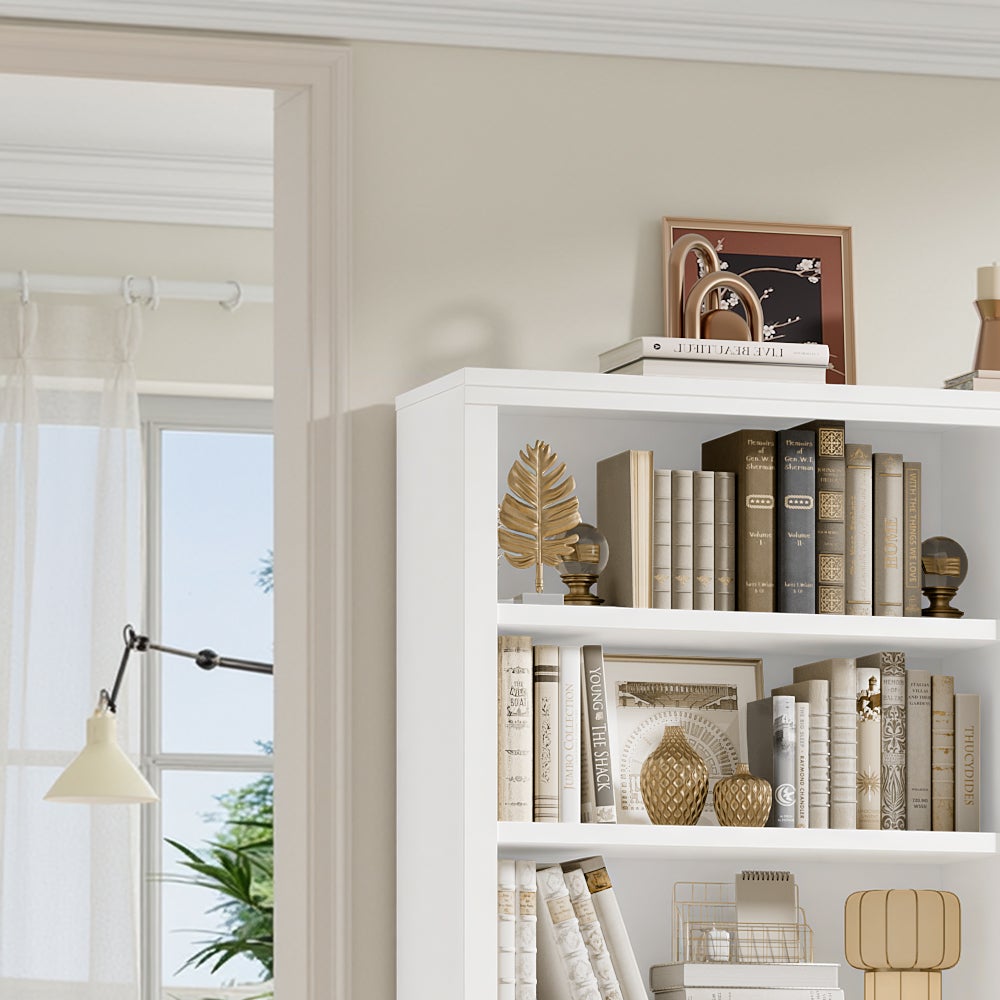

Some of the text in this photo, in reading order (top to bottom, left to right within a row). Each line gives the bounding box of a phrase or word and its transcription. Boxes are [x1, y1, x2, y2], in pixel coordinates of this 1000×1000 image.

[784, 463, 814, 471] Sherman
[884, 518, 898, 569] HOME
[909, 473, 917, 582] WITH THE THINGS WE LOVE
[564, 683, 576, 751] COLLECTION
[589, 667, 611, 792] YOUNG THE SHACK
[964, 725, 975, 806] THUCYDIDES
